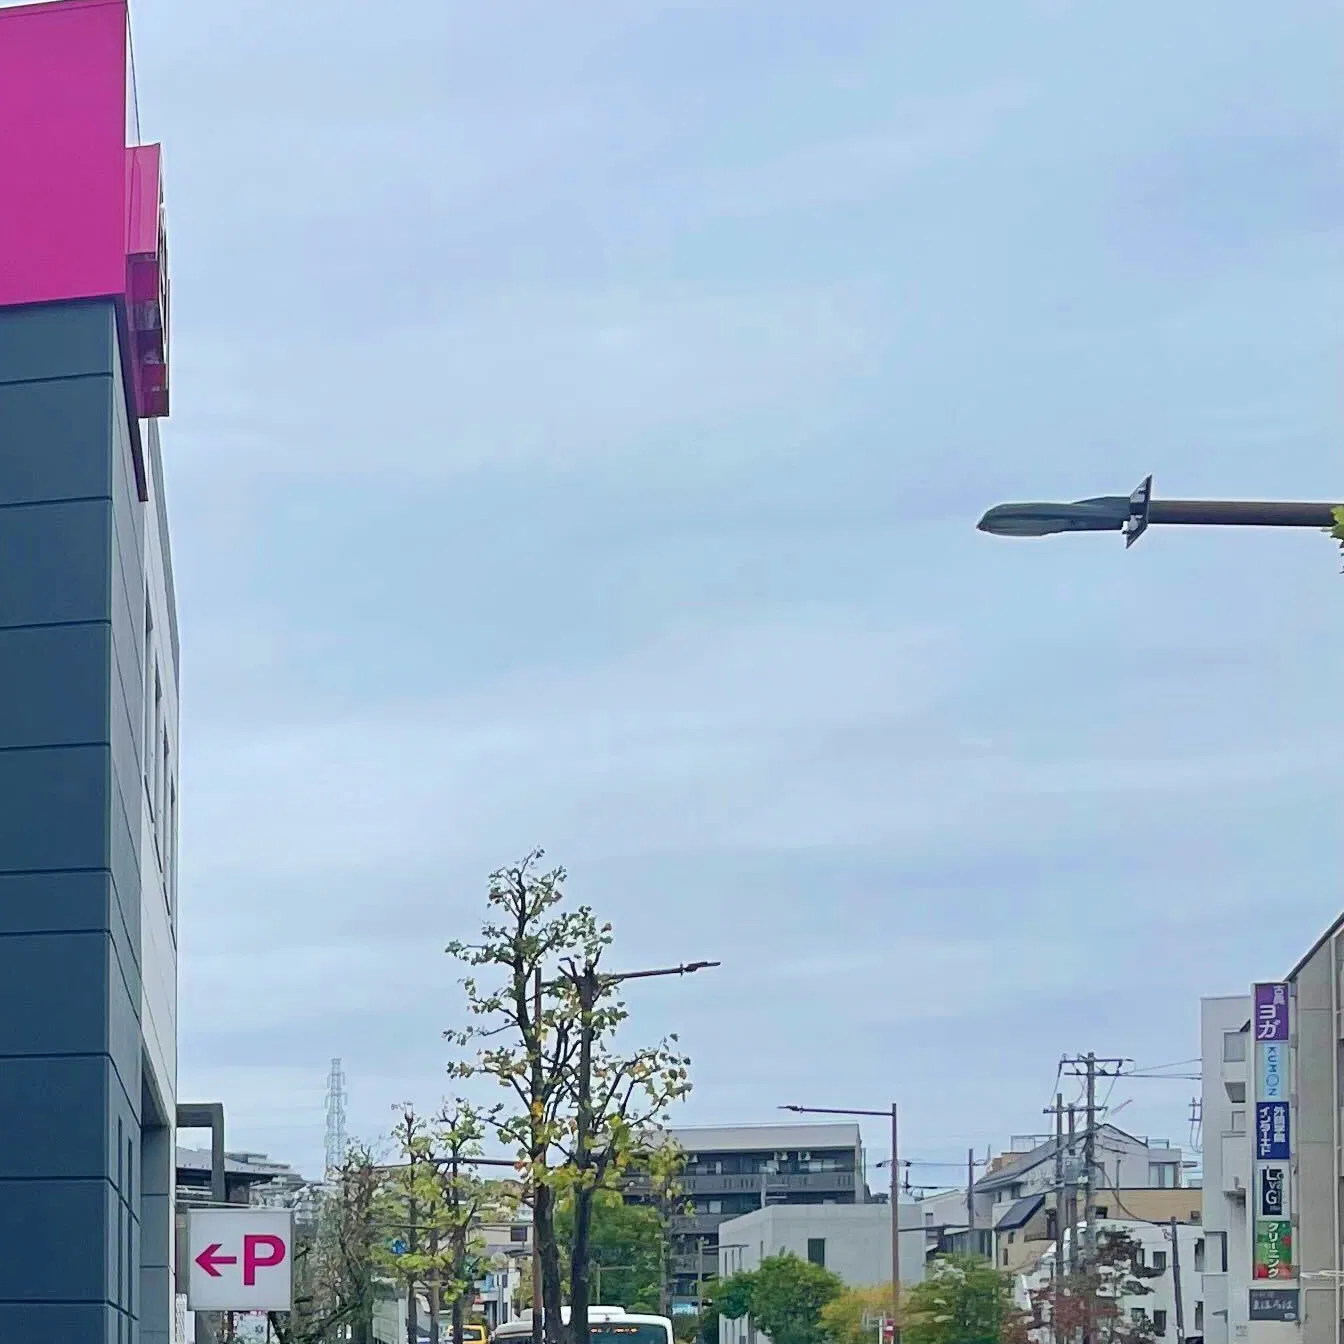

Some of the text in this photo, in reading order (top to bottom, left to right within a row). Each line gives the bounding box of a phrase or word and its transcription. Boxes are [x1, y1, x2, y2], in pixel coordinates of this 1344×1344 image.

[1258, 1005, 1281, 1039] ヨガ
[1266, 1046, 1279, 1096] KUMON
[243, 1234, 286, 1286] P
[1268, 1222, 1279, 1279] クリーニング
